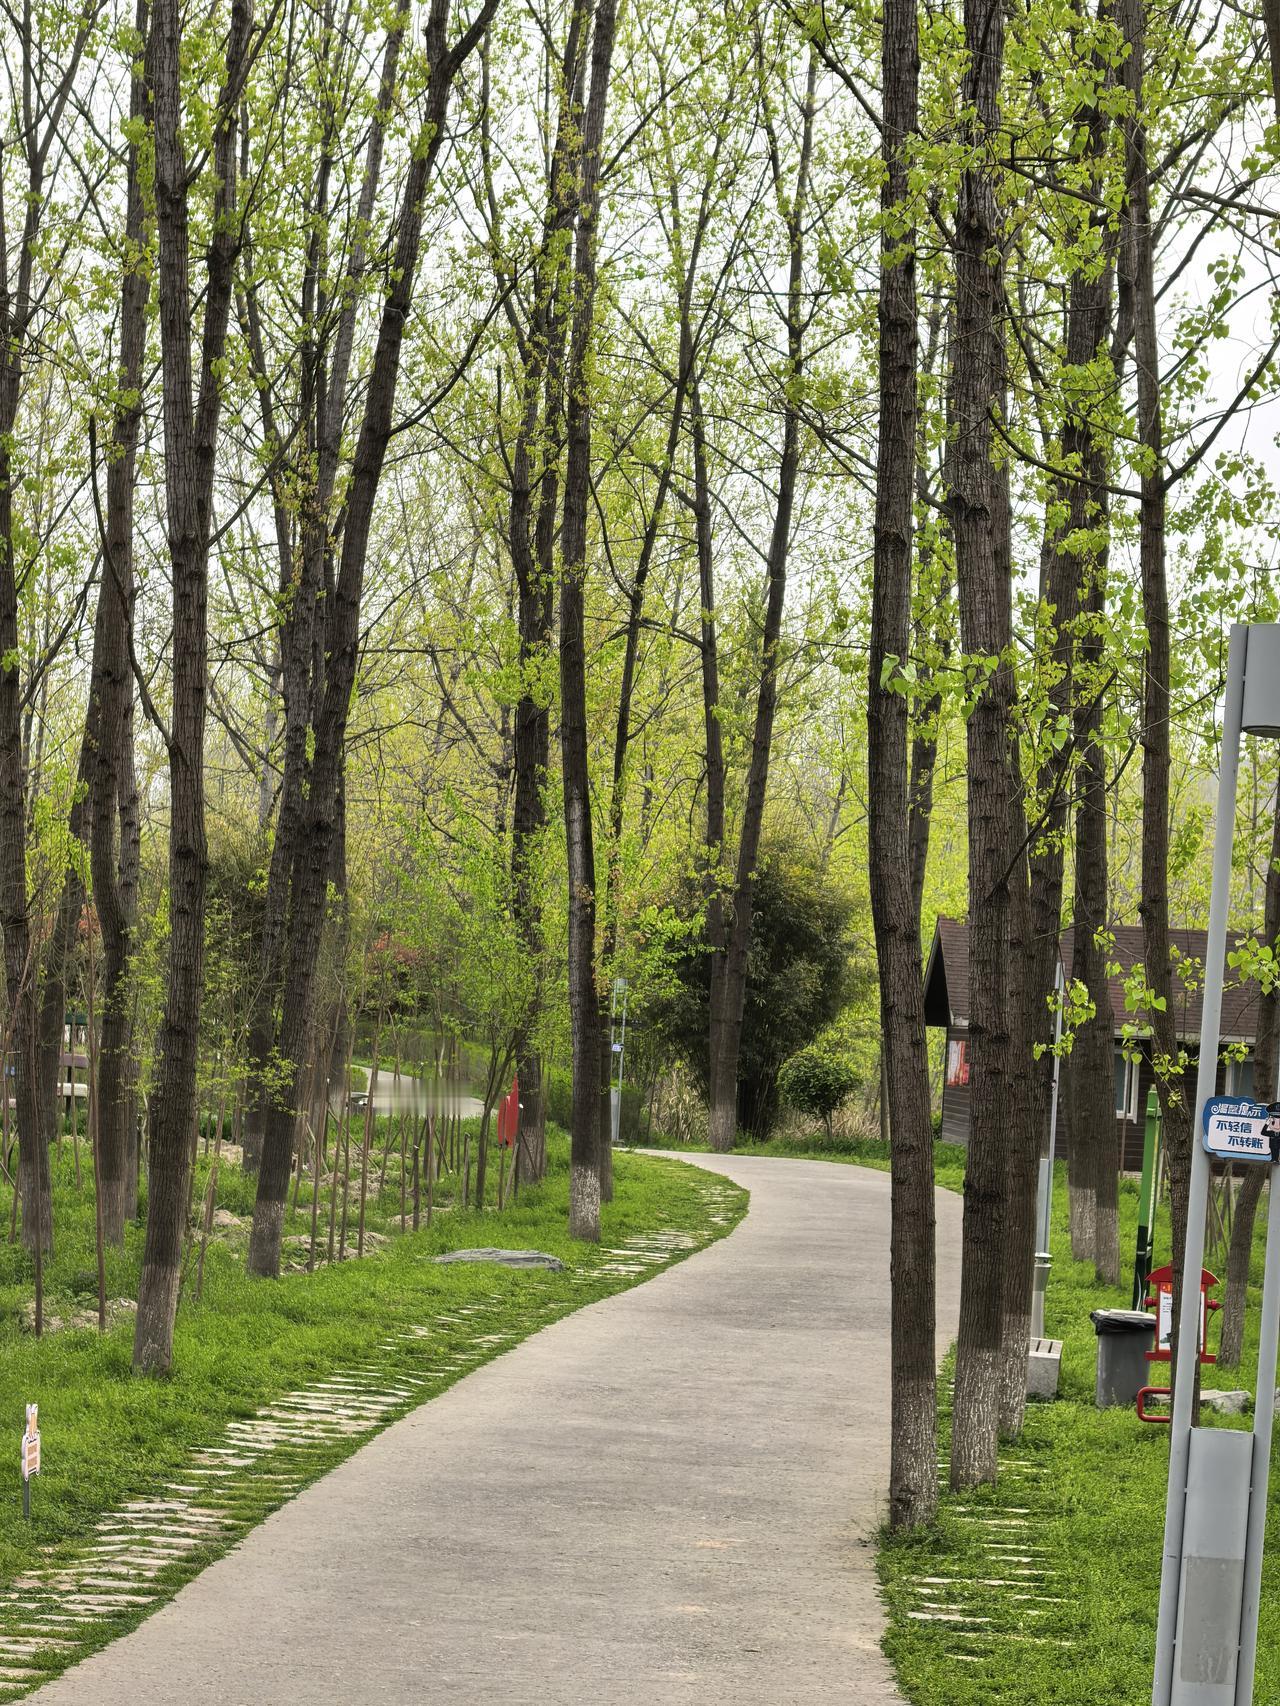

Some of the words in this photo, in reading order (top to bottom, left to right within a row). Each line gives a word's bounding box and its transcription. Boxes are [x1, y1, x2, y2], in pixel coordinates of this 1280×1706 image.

[1216, 1120, 1252, 1133] 不轻信
[1228, 1136, 1263, 1149] 不转账
